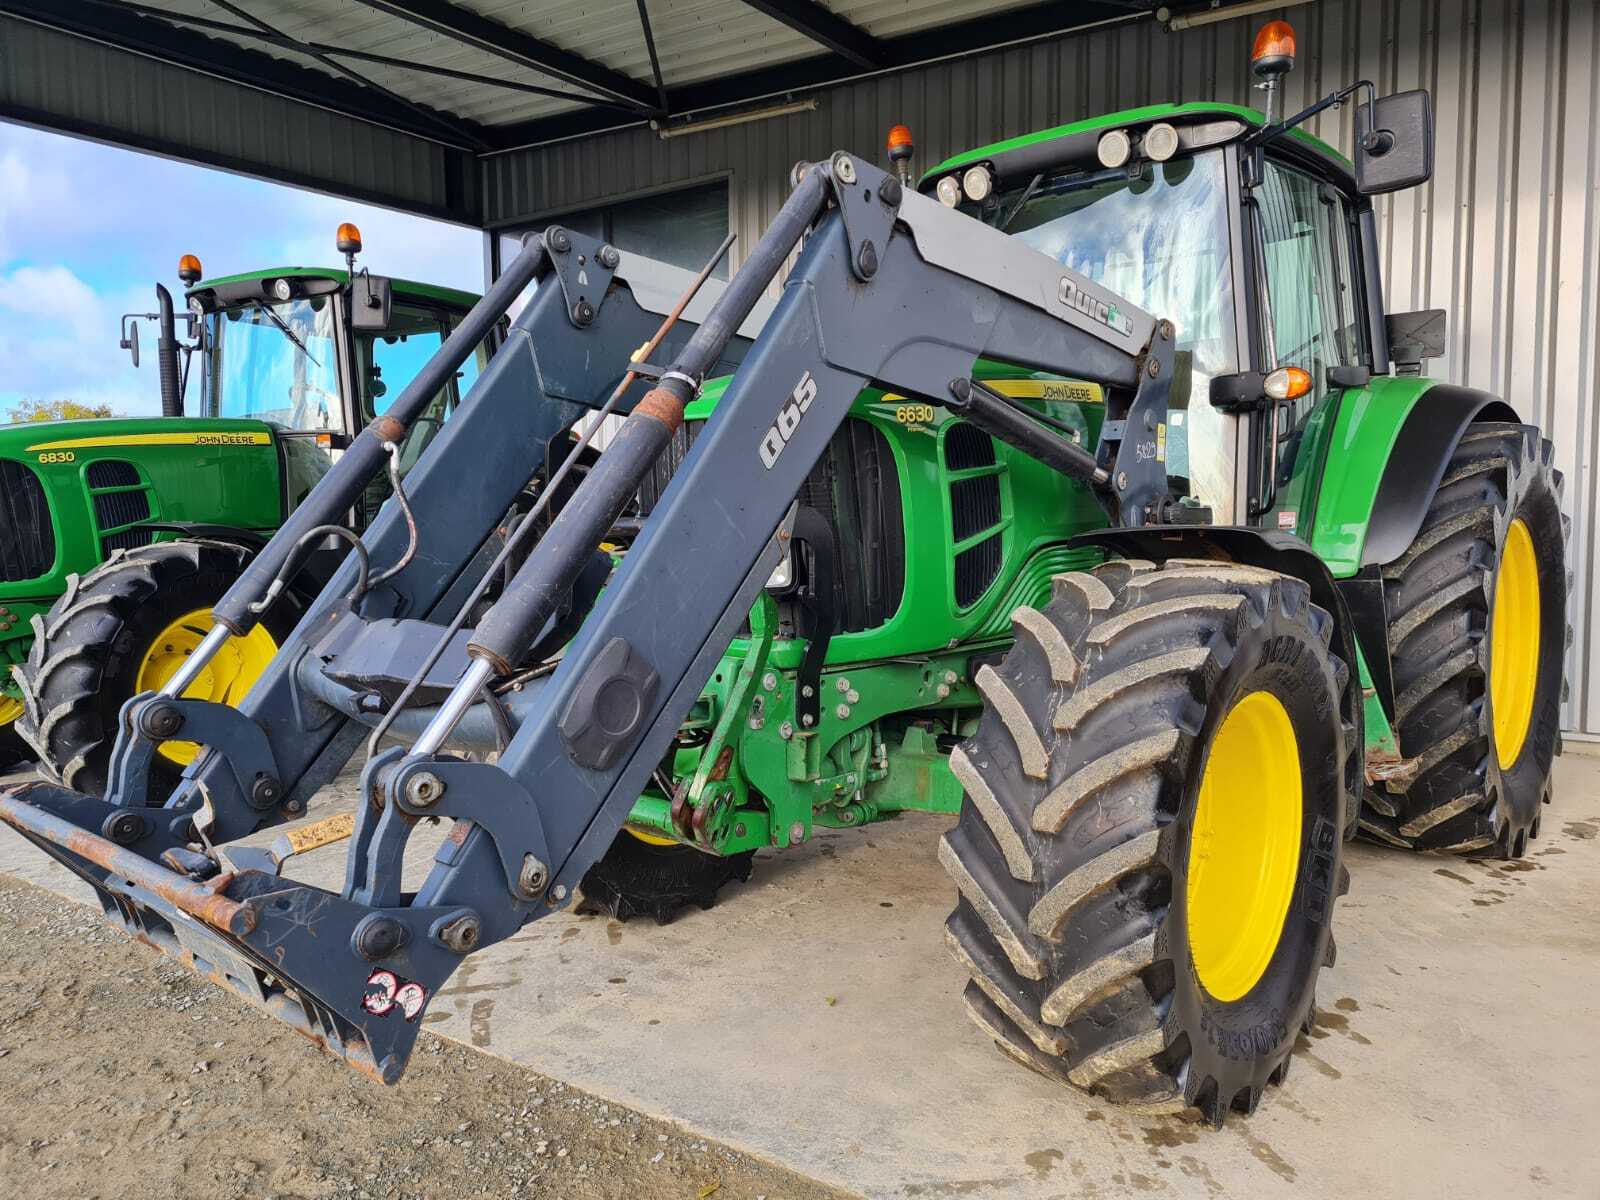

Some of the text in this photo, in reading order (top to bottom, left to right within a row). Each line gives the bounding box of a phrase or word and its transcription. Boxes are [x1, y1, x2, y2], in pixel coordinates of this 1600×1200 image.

[1043, 383, 1092, 400] JOHN DEERE
[759, 370, 818, 470] Q65
[896, 405, 935, 423] 6630
[194, 434, 255, 444] JOHN DEERE
[38, 451, 75, 464] 6830
[1303, 816, 1337, 927] BKT
